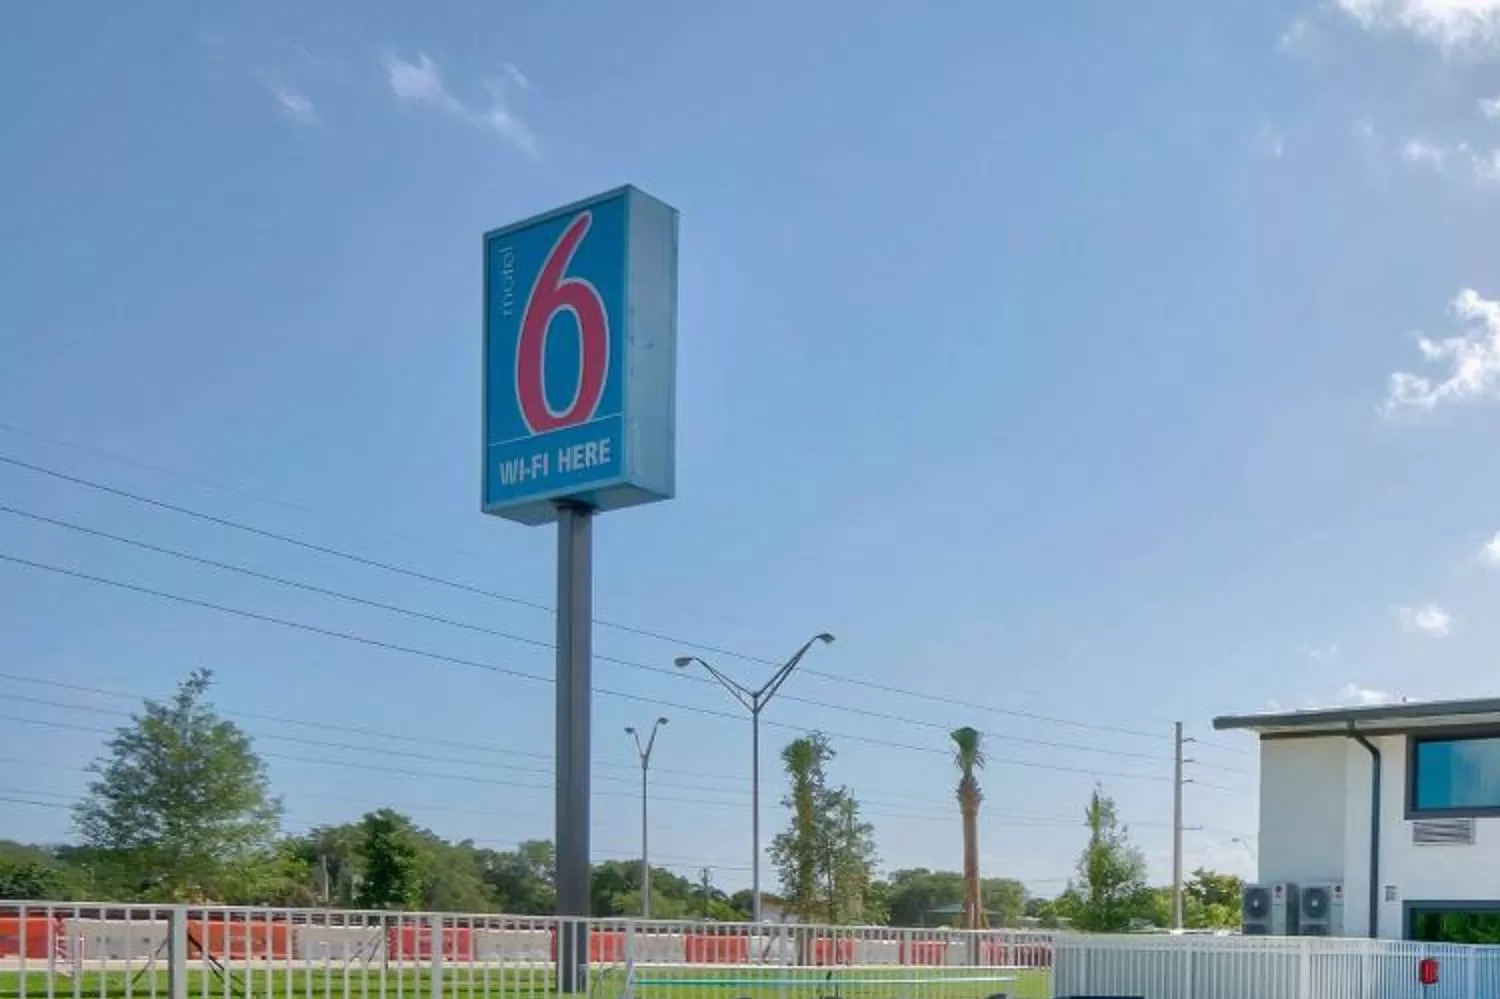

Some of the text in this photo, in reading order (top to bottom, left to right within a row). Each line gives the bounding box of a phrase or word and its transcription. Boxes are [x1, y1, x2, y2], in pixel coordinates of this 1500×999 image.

[514, 209, 611, 437] 6
[500, 437, 612, 486] WI-FI HERE
